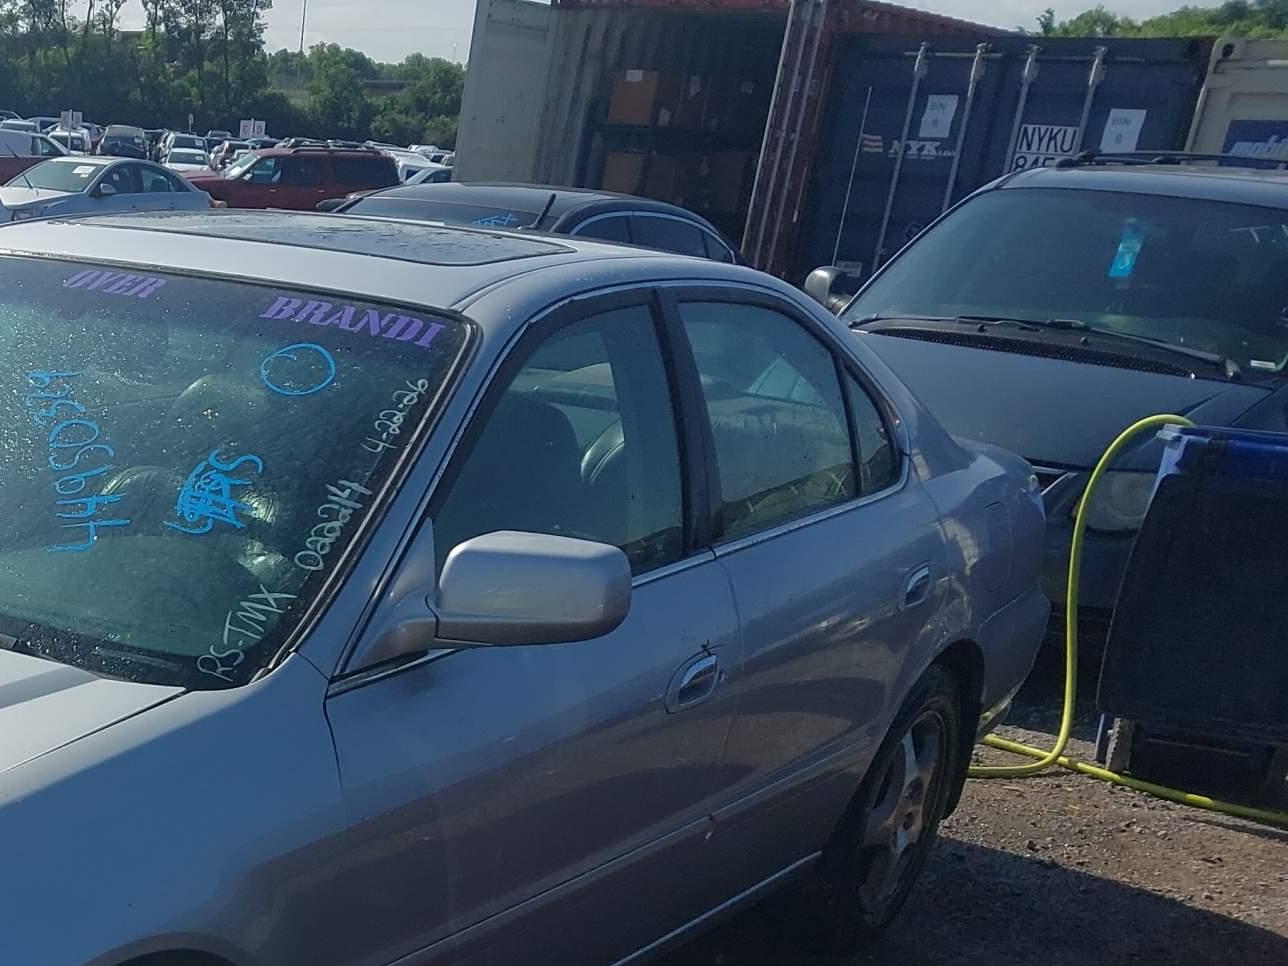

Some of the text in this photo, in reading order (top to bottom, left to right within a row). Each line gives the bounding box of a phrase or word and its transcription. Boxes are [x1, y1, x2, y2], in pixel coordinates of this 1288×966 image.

[1018, 126, 1078, 153] NYKU
[62, 270, 167, 300] OVER
[258, 296, 446, 348] BRANDI
